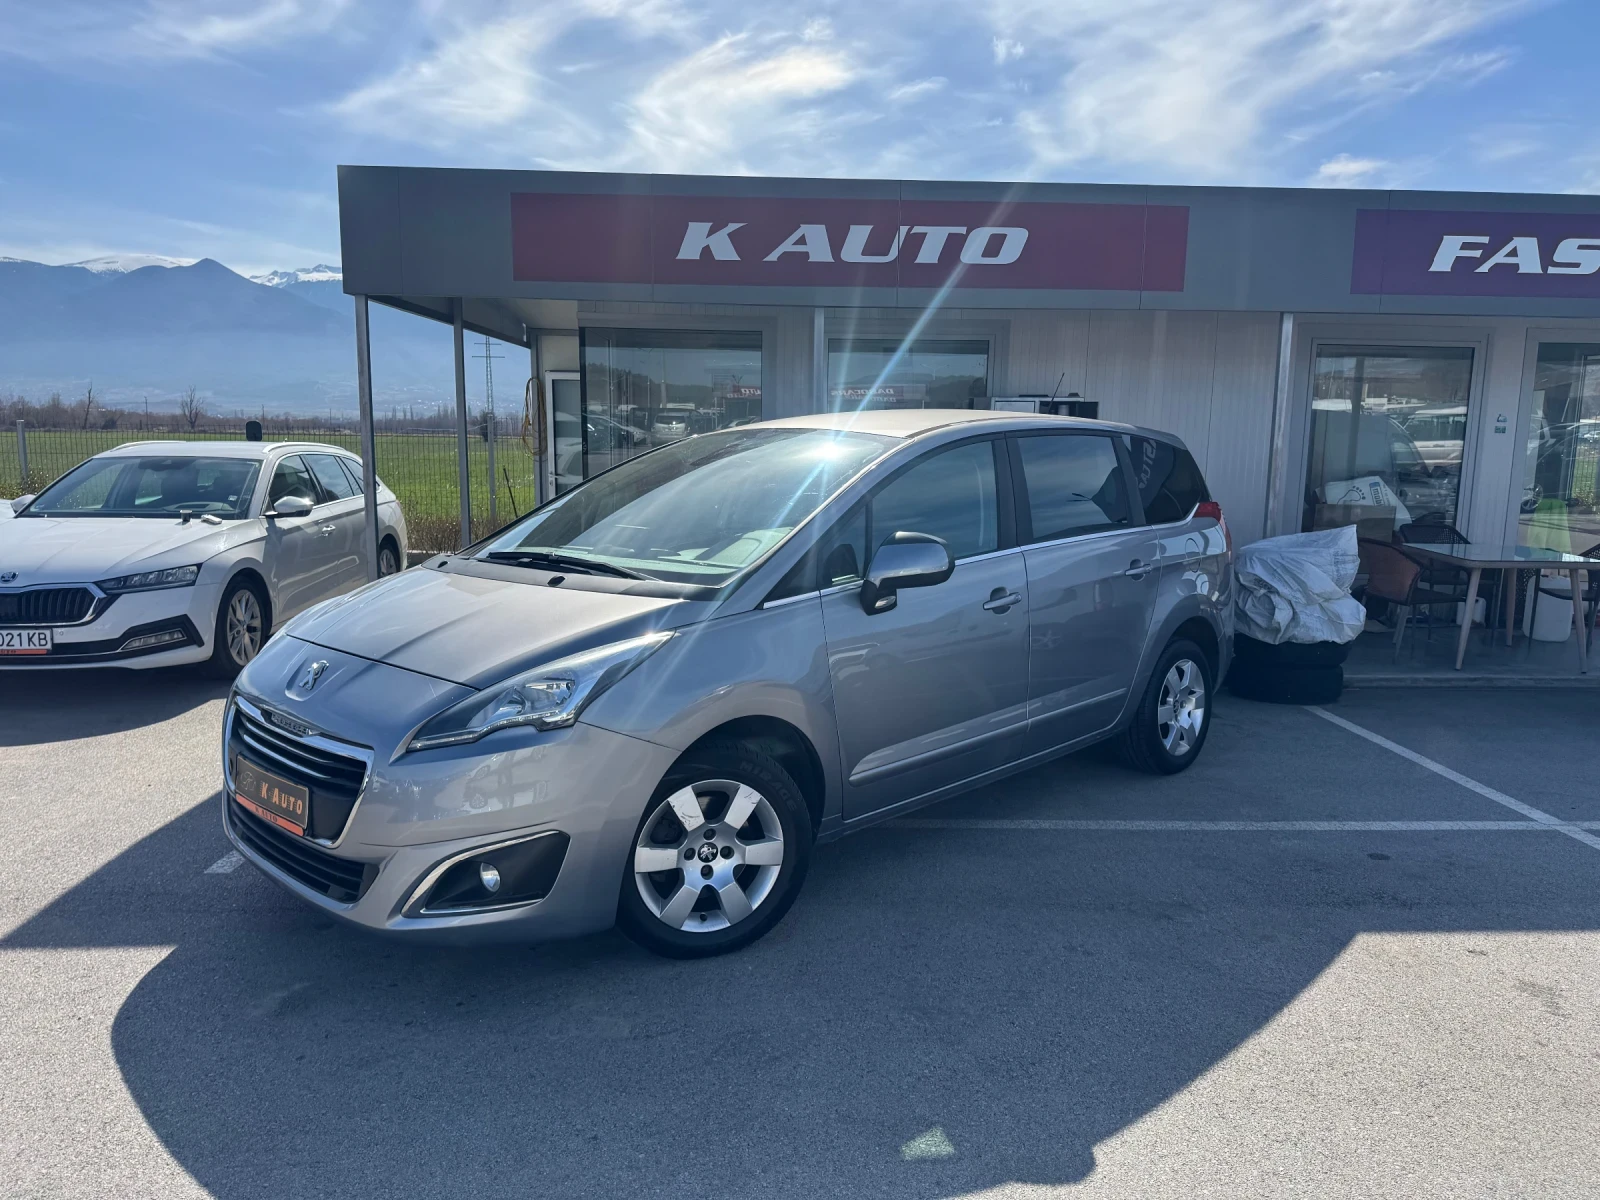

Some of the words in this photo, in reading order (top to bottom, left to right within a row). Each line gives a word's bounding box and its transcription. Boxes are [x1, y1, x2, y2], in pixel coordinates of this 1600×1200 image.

[676, 222, 747, 261] K
[764, 223, 1029, 265] AUTO
[1428, 235, 1600, 275] FAS
[261, 782, 268, 799] K
[272, 788, 303, 815] AUTO
[740, 760, 797, 811] MIRAGE
